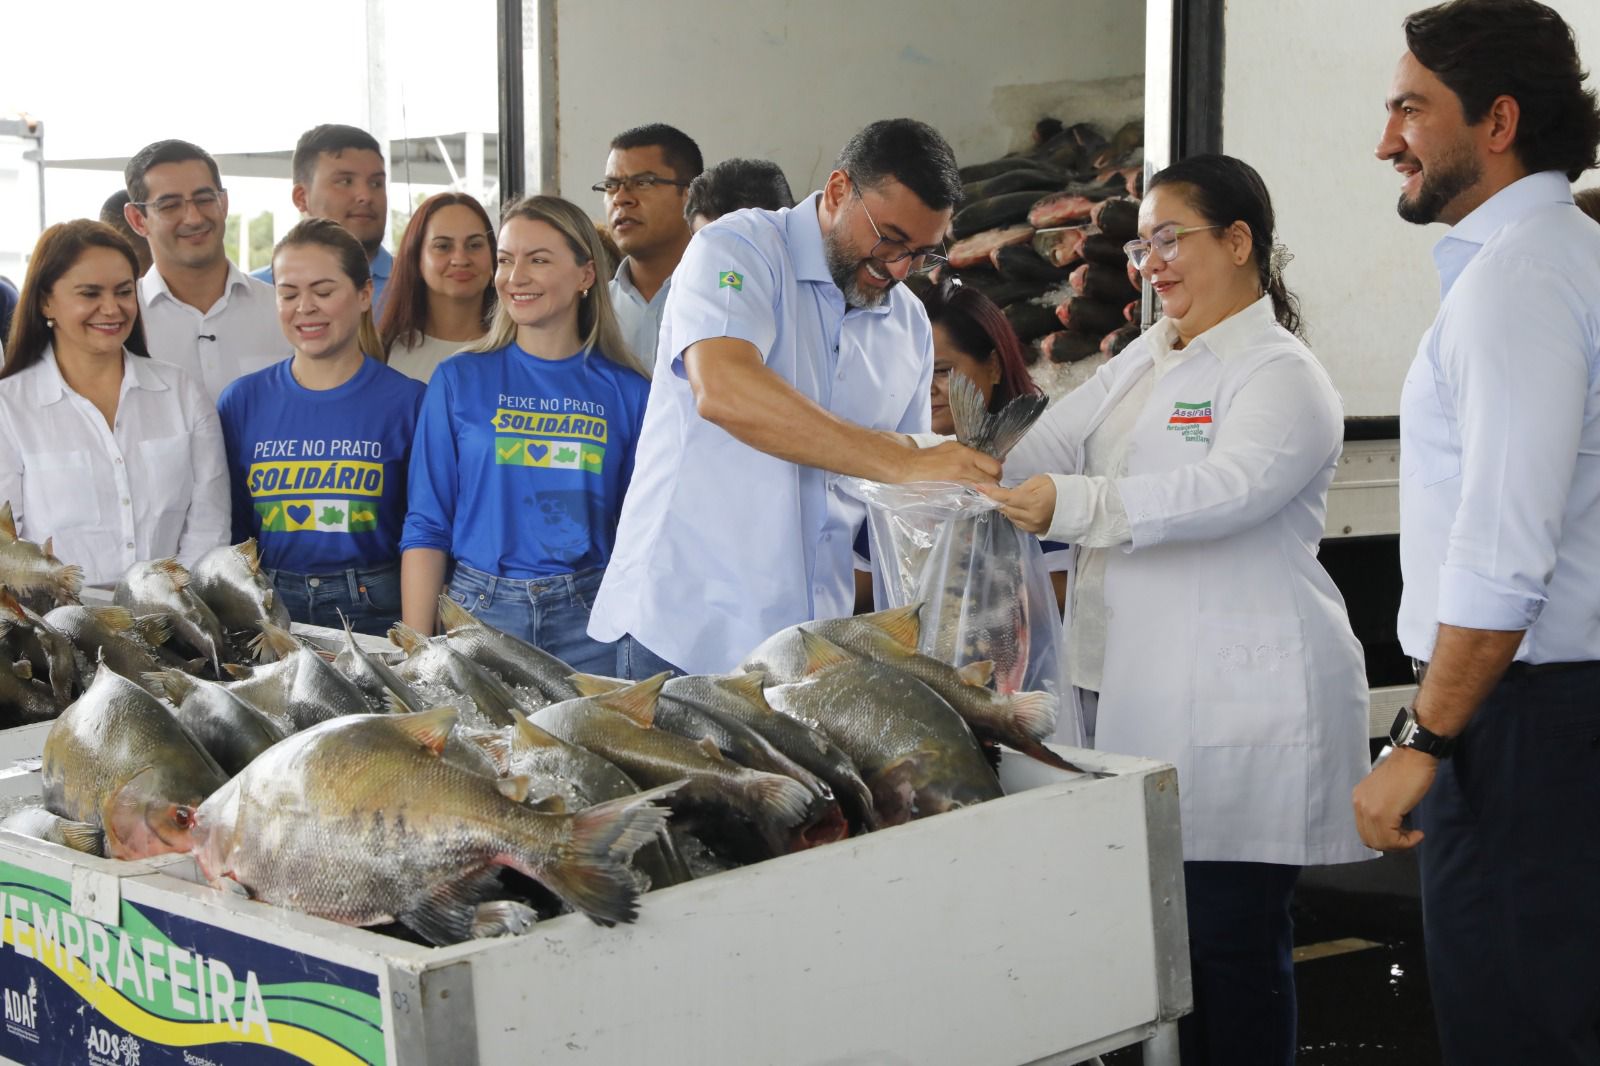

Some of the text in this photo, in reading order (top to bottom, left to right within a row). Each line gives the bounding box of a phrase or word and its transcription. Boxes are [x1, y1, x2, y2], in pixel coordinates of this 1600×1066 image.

[498, 393, 605, 416] PEIXE NO PRATO
[497, 413, 606, 438] SOLIDÁRIO
[253, 439, 382, 459] PEIXE NO PRATO
[250, 461, 382, 493] SOLIDÁRIO
[4, 986, 38, 1030] ADAF
[87, 1025, 120, 1061] ADS
